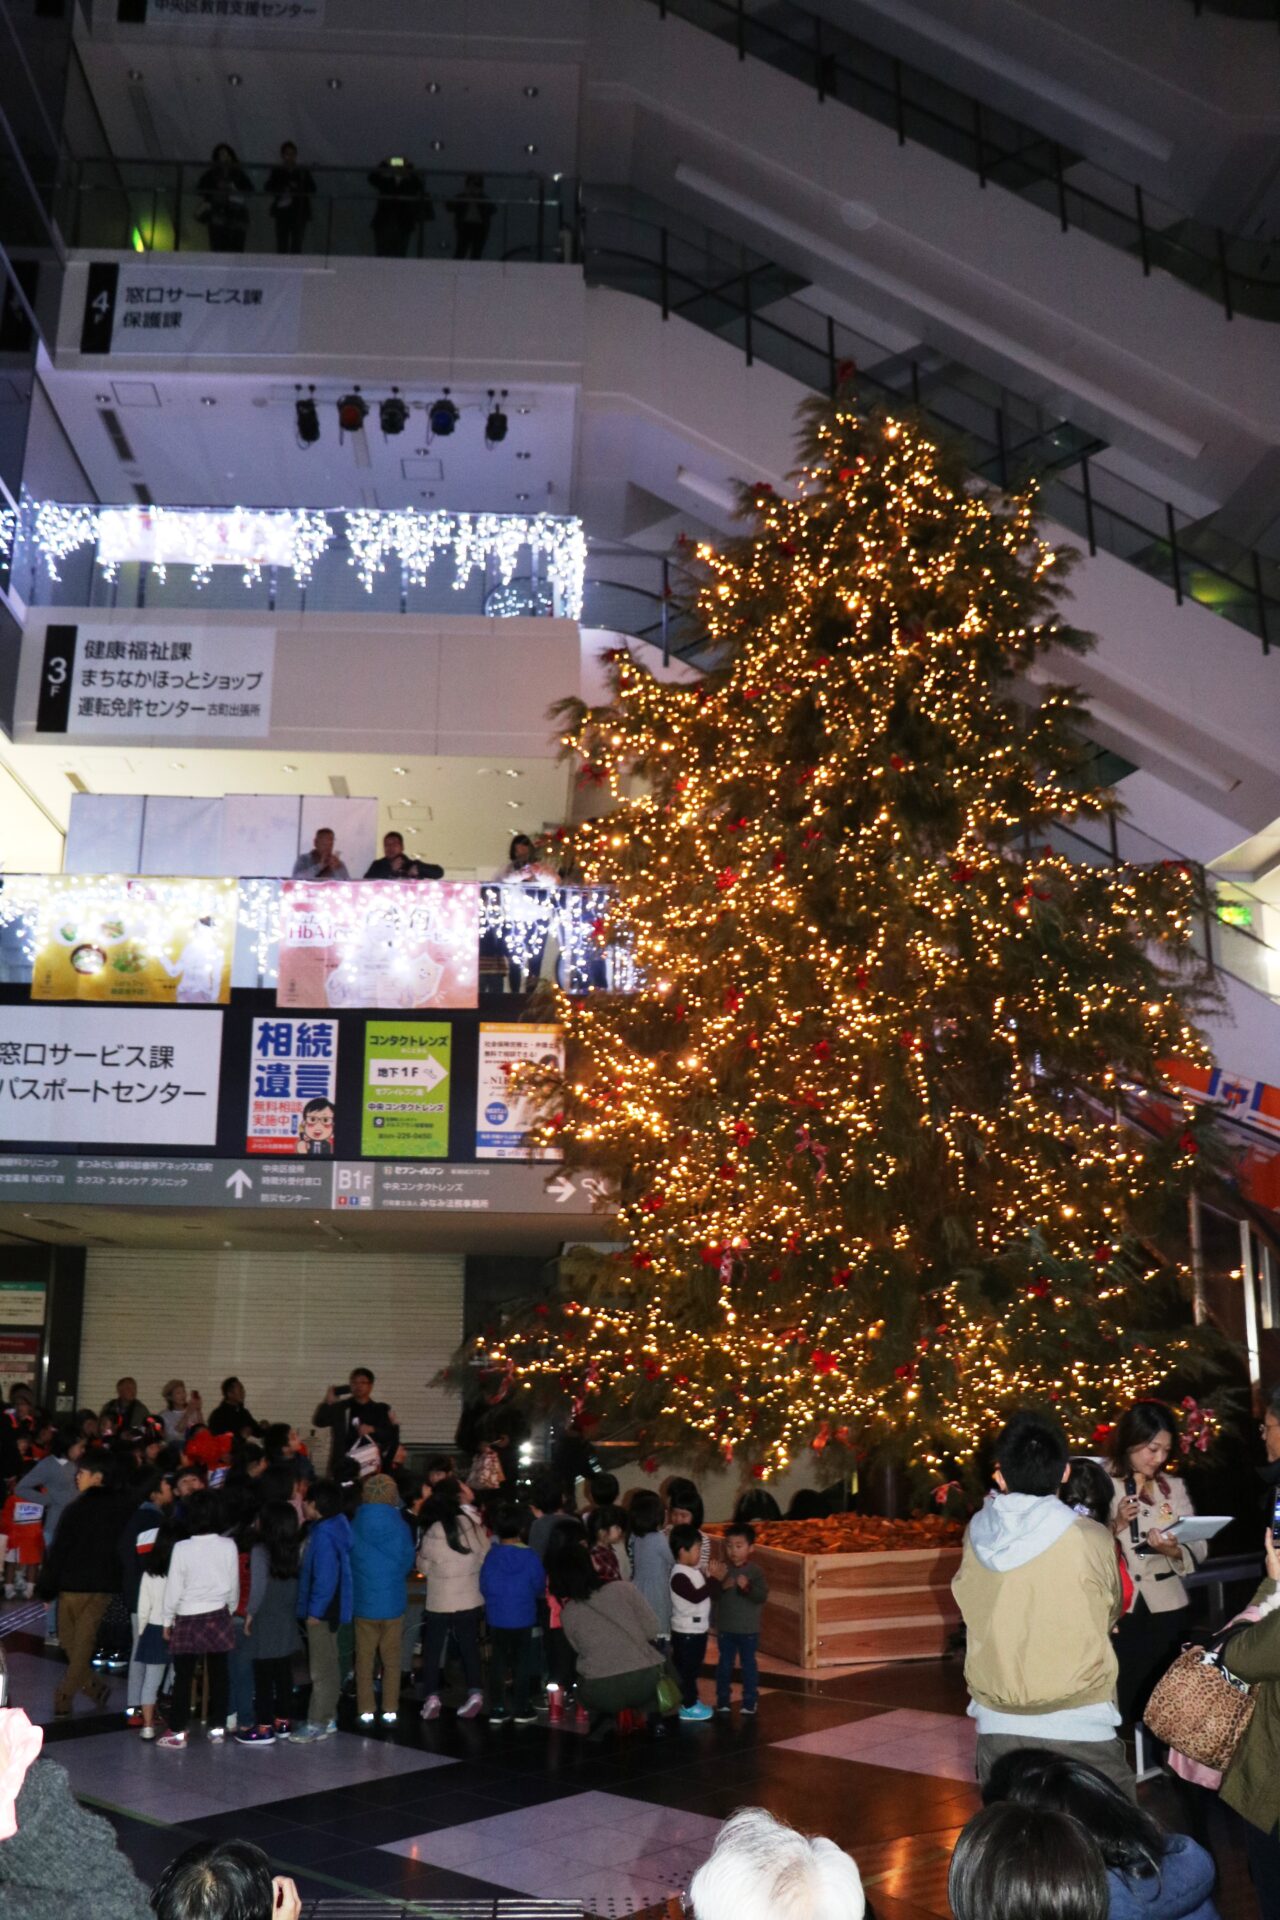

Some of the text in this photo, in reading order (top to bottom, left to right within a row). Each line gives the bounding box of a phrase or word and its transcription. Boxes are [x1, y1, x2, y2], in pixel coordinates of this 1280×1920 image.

[126, 287, 263, 305] 窓口サービス課
[123, 311, 182, 329] 保護課
[84, 640, 192, 661] 健康福祉課
[47, 657, 68, 684] 3
[81, 669, 263, 690] まちなかほっとショップ
[77, 697, 206, 718] 運転免許センター
[257, 1021, 333, 1058] 相続
[369, 1035, 449, 1047] コンタクトレンズ
[0, 1041, 175, 1070] 窓口サービス課
[0, 1077, 207, 1105] パスポートセンター
[254, 1063, 331, 1099] 遺言
[253, 1101, 304, 1113] 無料相談
[367, 1102, 445, 1112] 中央コンタクトレンズ
[253, 1115, 289, 1127] 実施中
[151, 1178, 188, 1187] クリニック
[338, 1169, 372, 1190] B1F
[383, 1182, 464, 1192] 中央コンタクトレンズ
